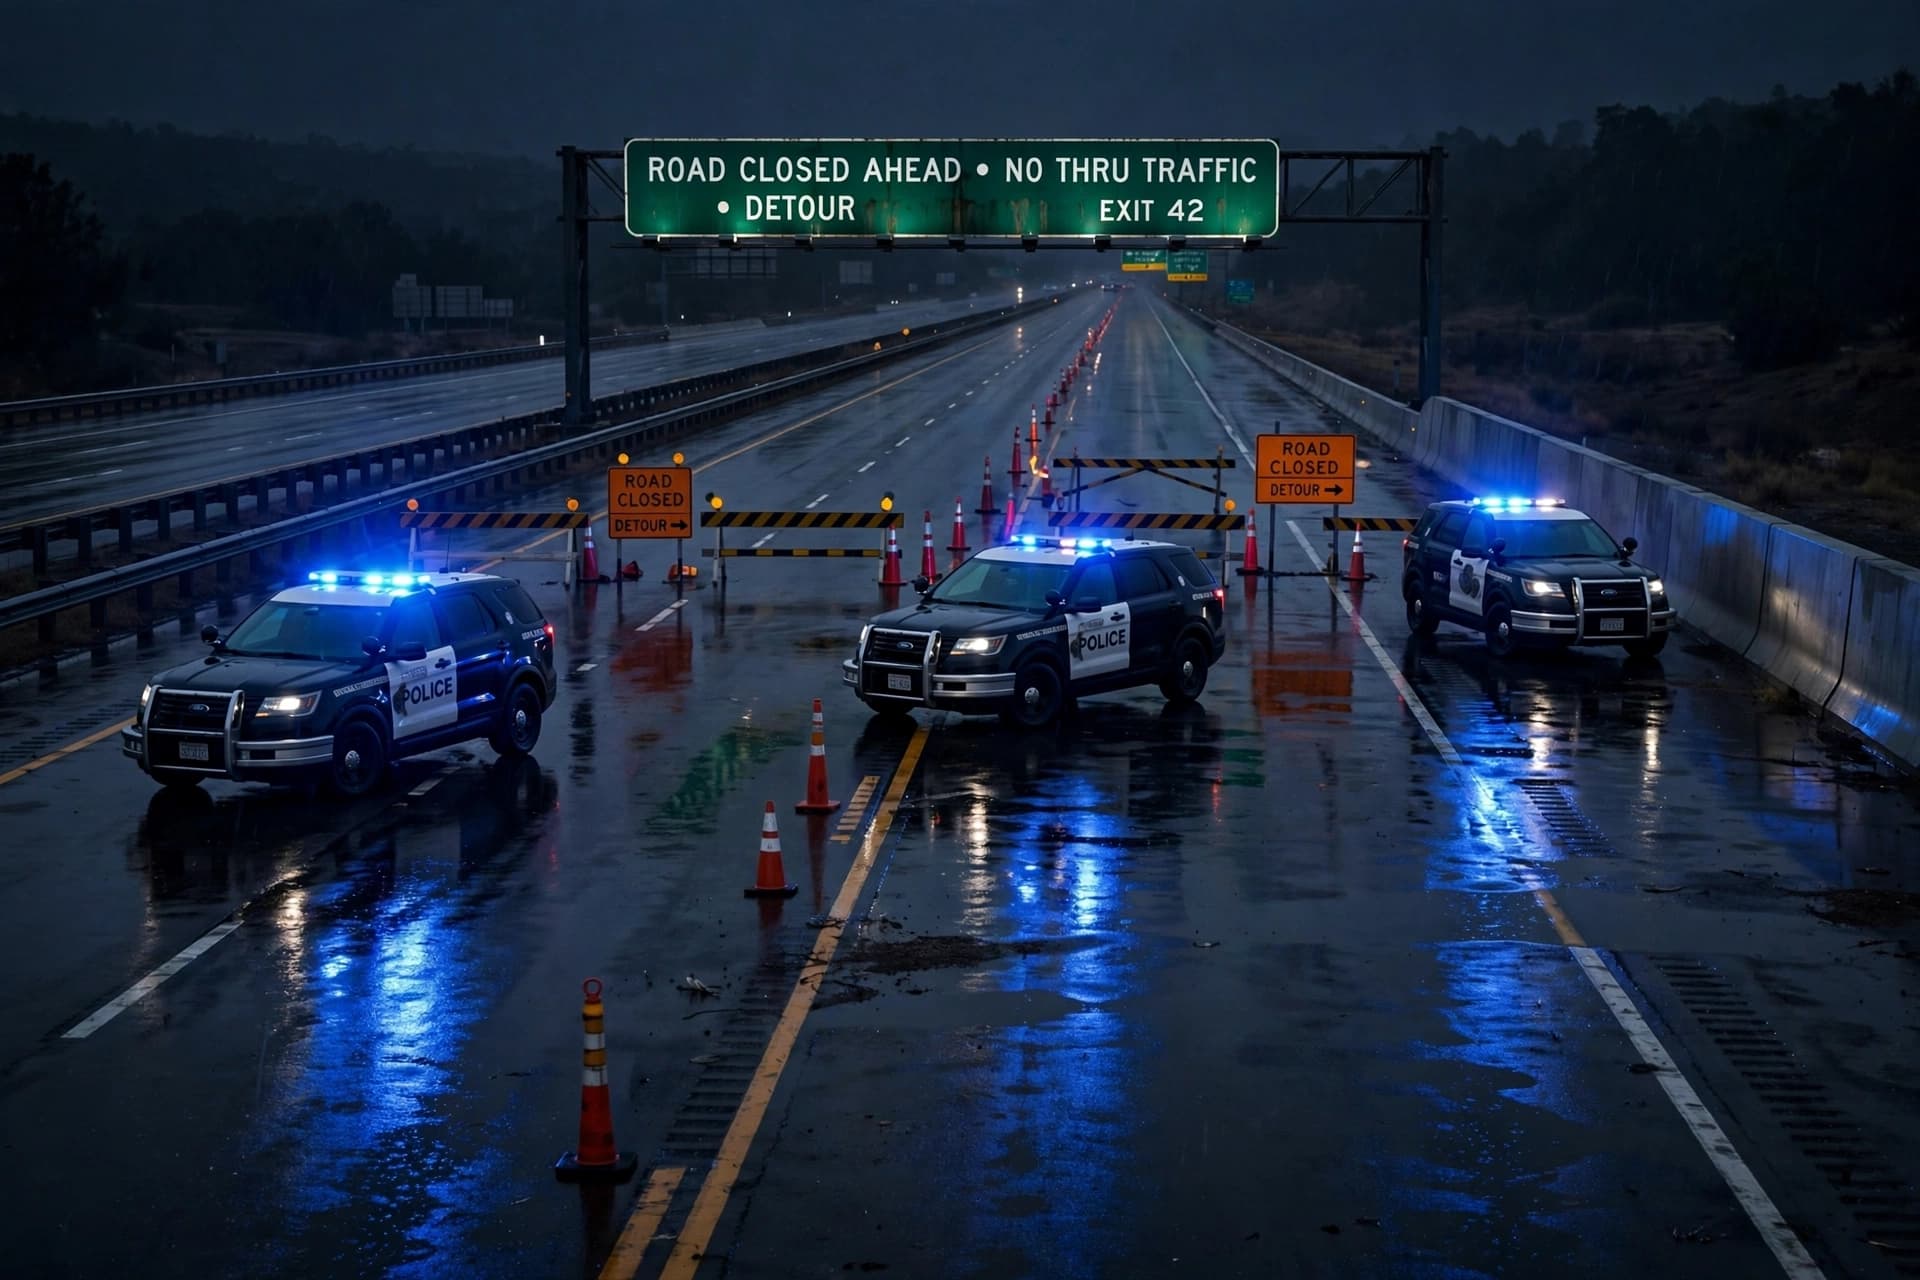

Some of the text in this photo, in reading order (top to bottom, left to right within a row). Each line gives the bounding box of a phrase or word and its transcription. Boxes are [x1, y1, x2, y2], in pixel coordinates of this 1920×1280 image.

[648, 156, 1257, 183] ROAD CLOSED AHEAD NO THRU TRAFFIC
[746, 195, 855, 221] DETOUR
[1100, 199, 1204, 222] EXIT 42
[1282, 442, 1331, 456] ROAD
[1270, 460, 1338, 475] CLOSED
[625, 474, 672, 488] ROAD
[1270, 484, 1320, 496] DETOUR
[617, 492, 684, 507] CLOSED
[615, 519, 667, 532] DETOUR
[1080, 629, 1126, 651] POLICE
[402, 677, 453, 704] POLICE
